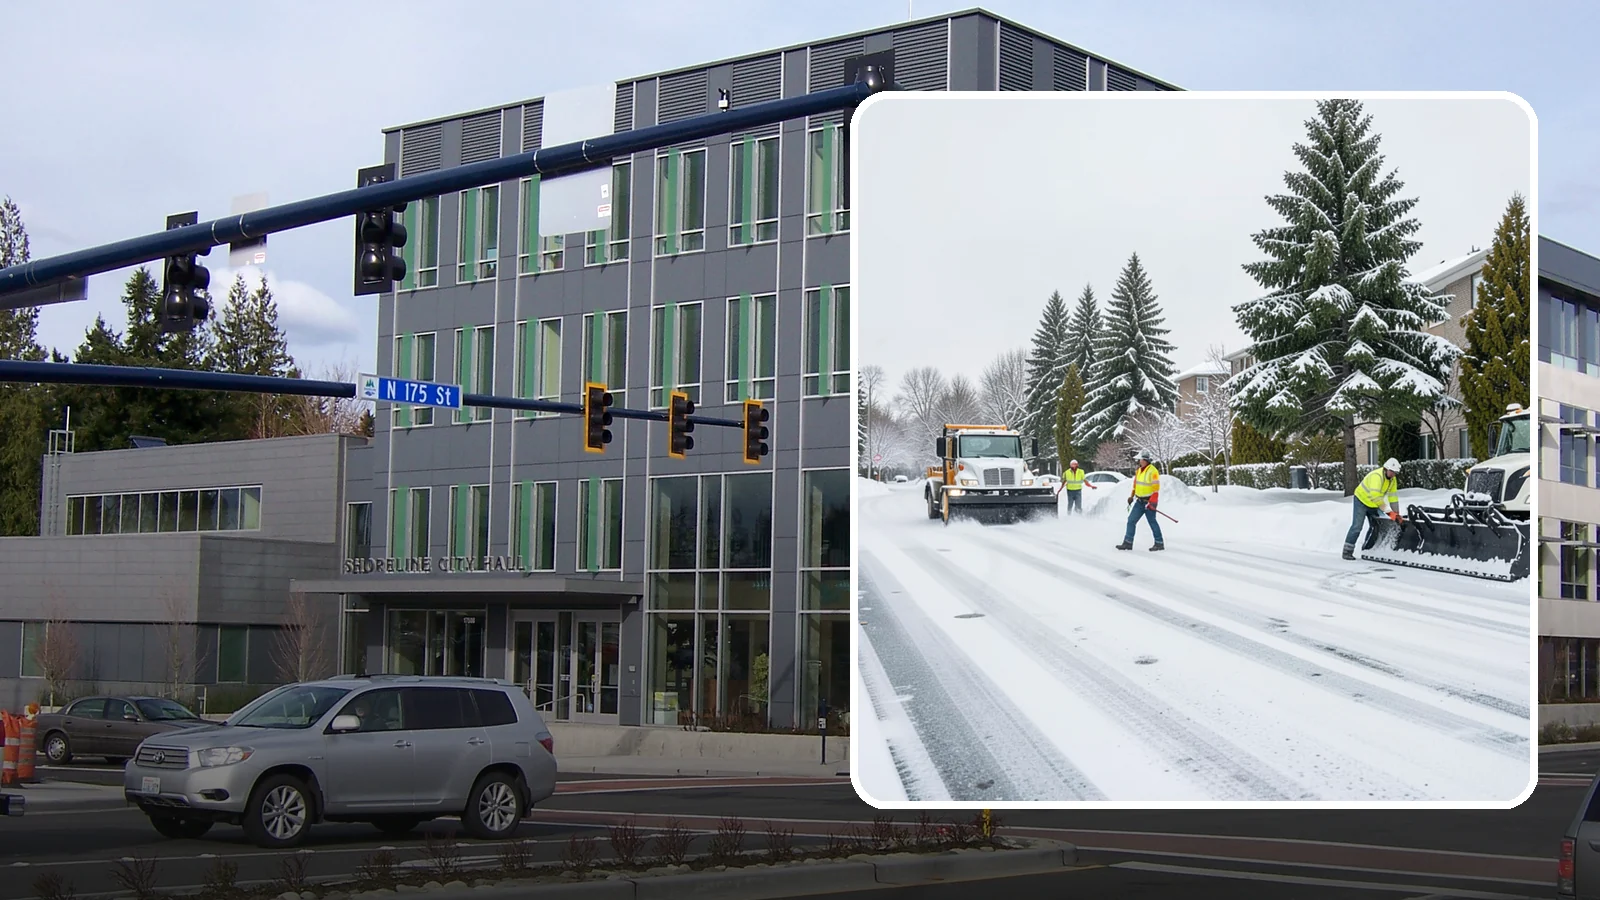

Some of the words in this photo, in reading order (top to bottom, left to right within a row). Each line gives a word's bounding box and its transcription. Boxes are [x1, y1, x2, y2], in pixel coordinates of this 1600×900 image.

[387, 380, 396, 400] N
[405, 382, 427, 403] 175
[436, 386, 451, 406] St
[344, 557, 431, 574] SHORELINE
[438, 556, 476, 572] CITY
[484, 556, 525, 572] HALL
